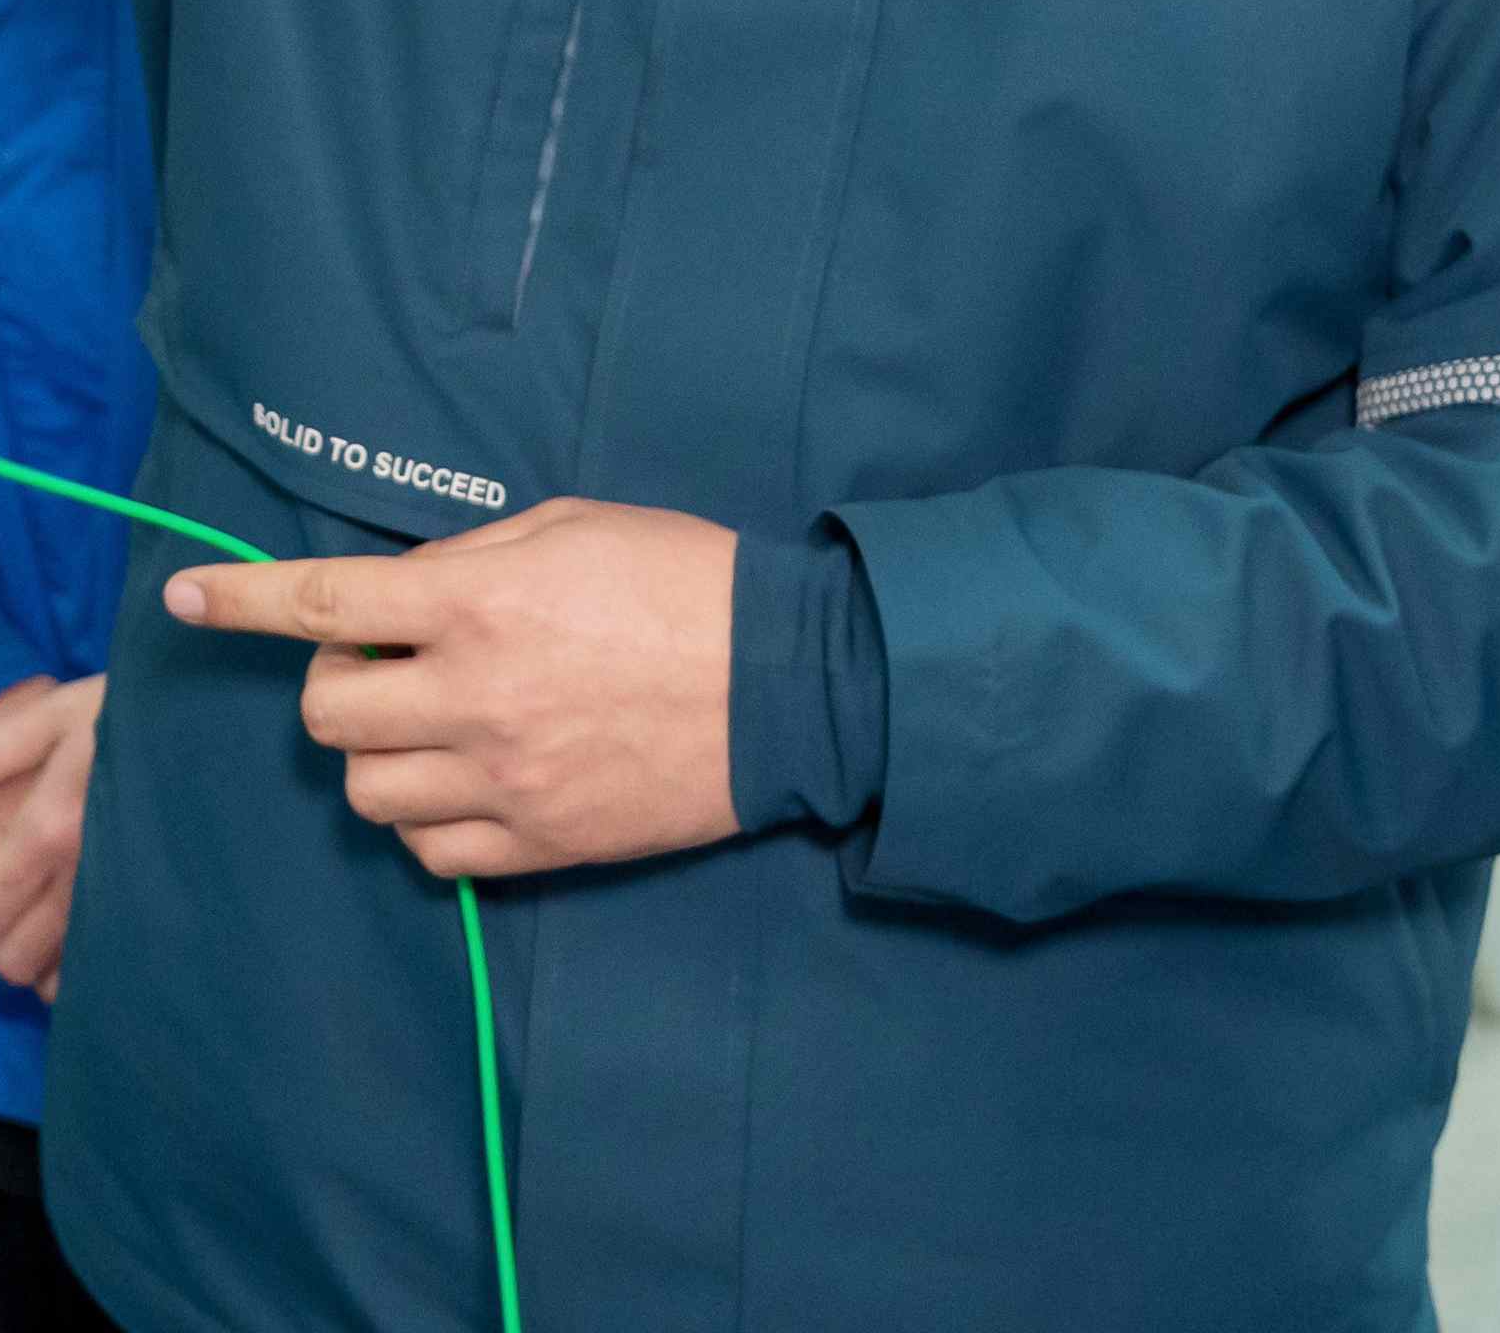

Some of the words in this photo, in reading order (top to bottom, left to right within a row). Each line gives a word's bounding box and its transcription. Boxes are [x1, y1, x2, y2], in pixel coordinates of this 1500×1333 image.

[252, 402, 324, 456] SOLID
[329, 436, 368, 471] TO
[372, 451, 508, 510] SUCCEED
